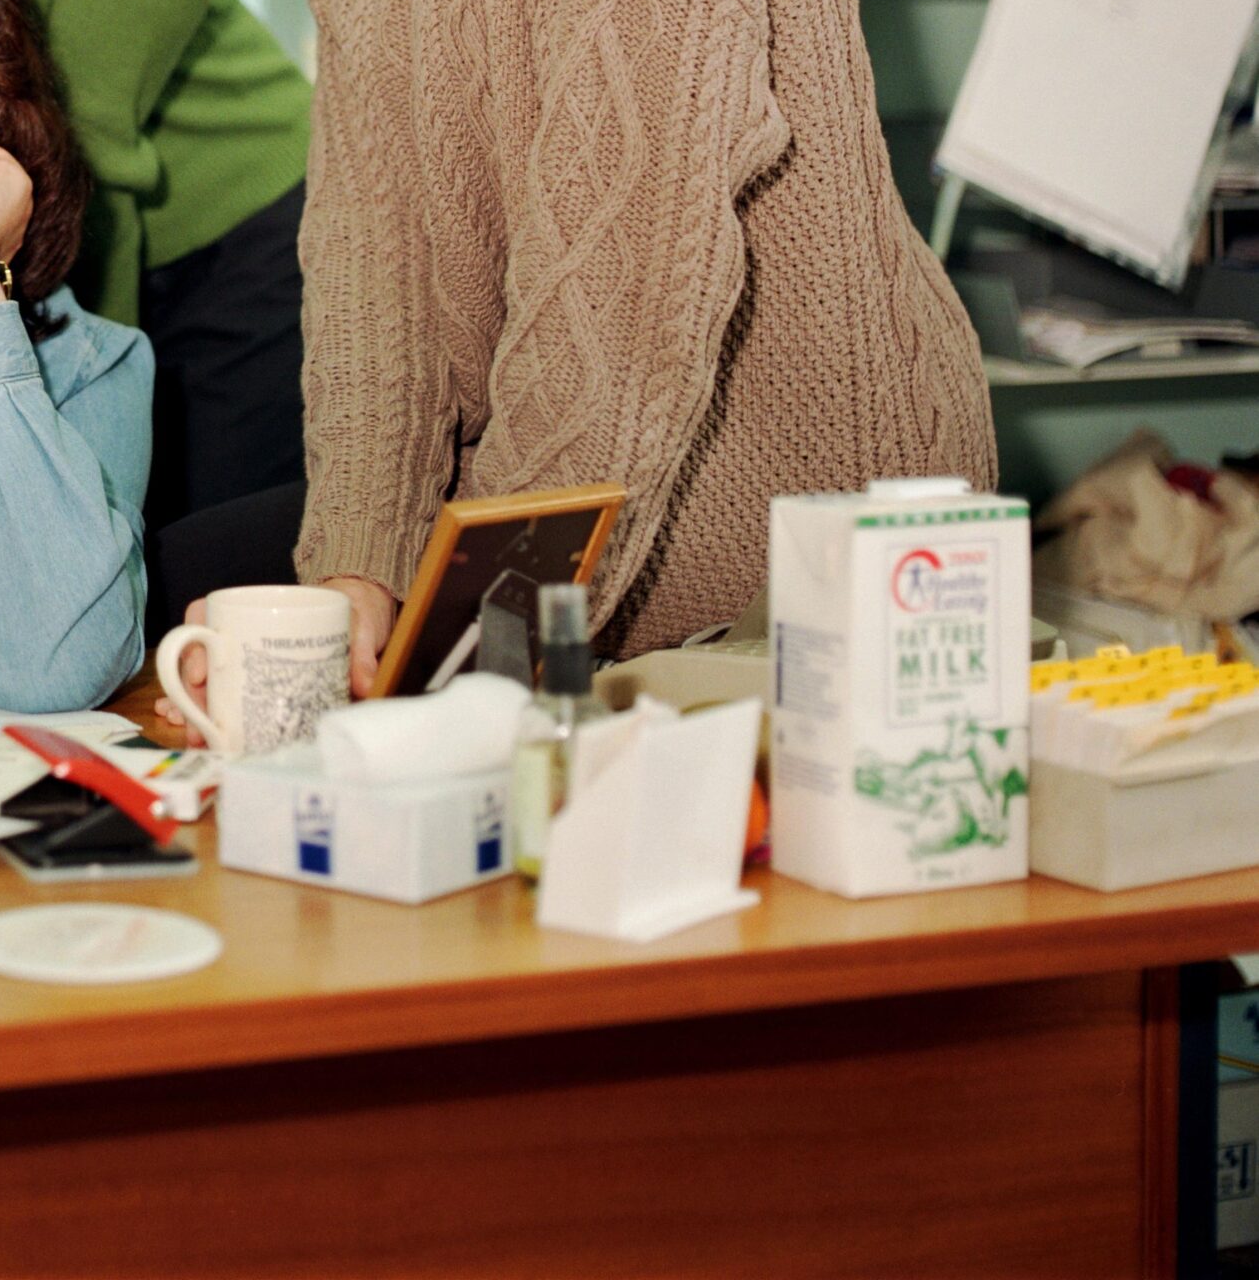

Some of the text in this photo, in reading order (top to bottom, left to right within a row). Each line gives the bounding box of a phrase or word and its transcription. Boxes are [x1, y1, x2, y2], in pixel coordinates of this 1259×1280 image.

[261, 637, 316, 649] THREAVE
[896, 622, 986, 647] FAT FREE
[897, 646, 987, 677] MILK
